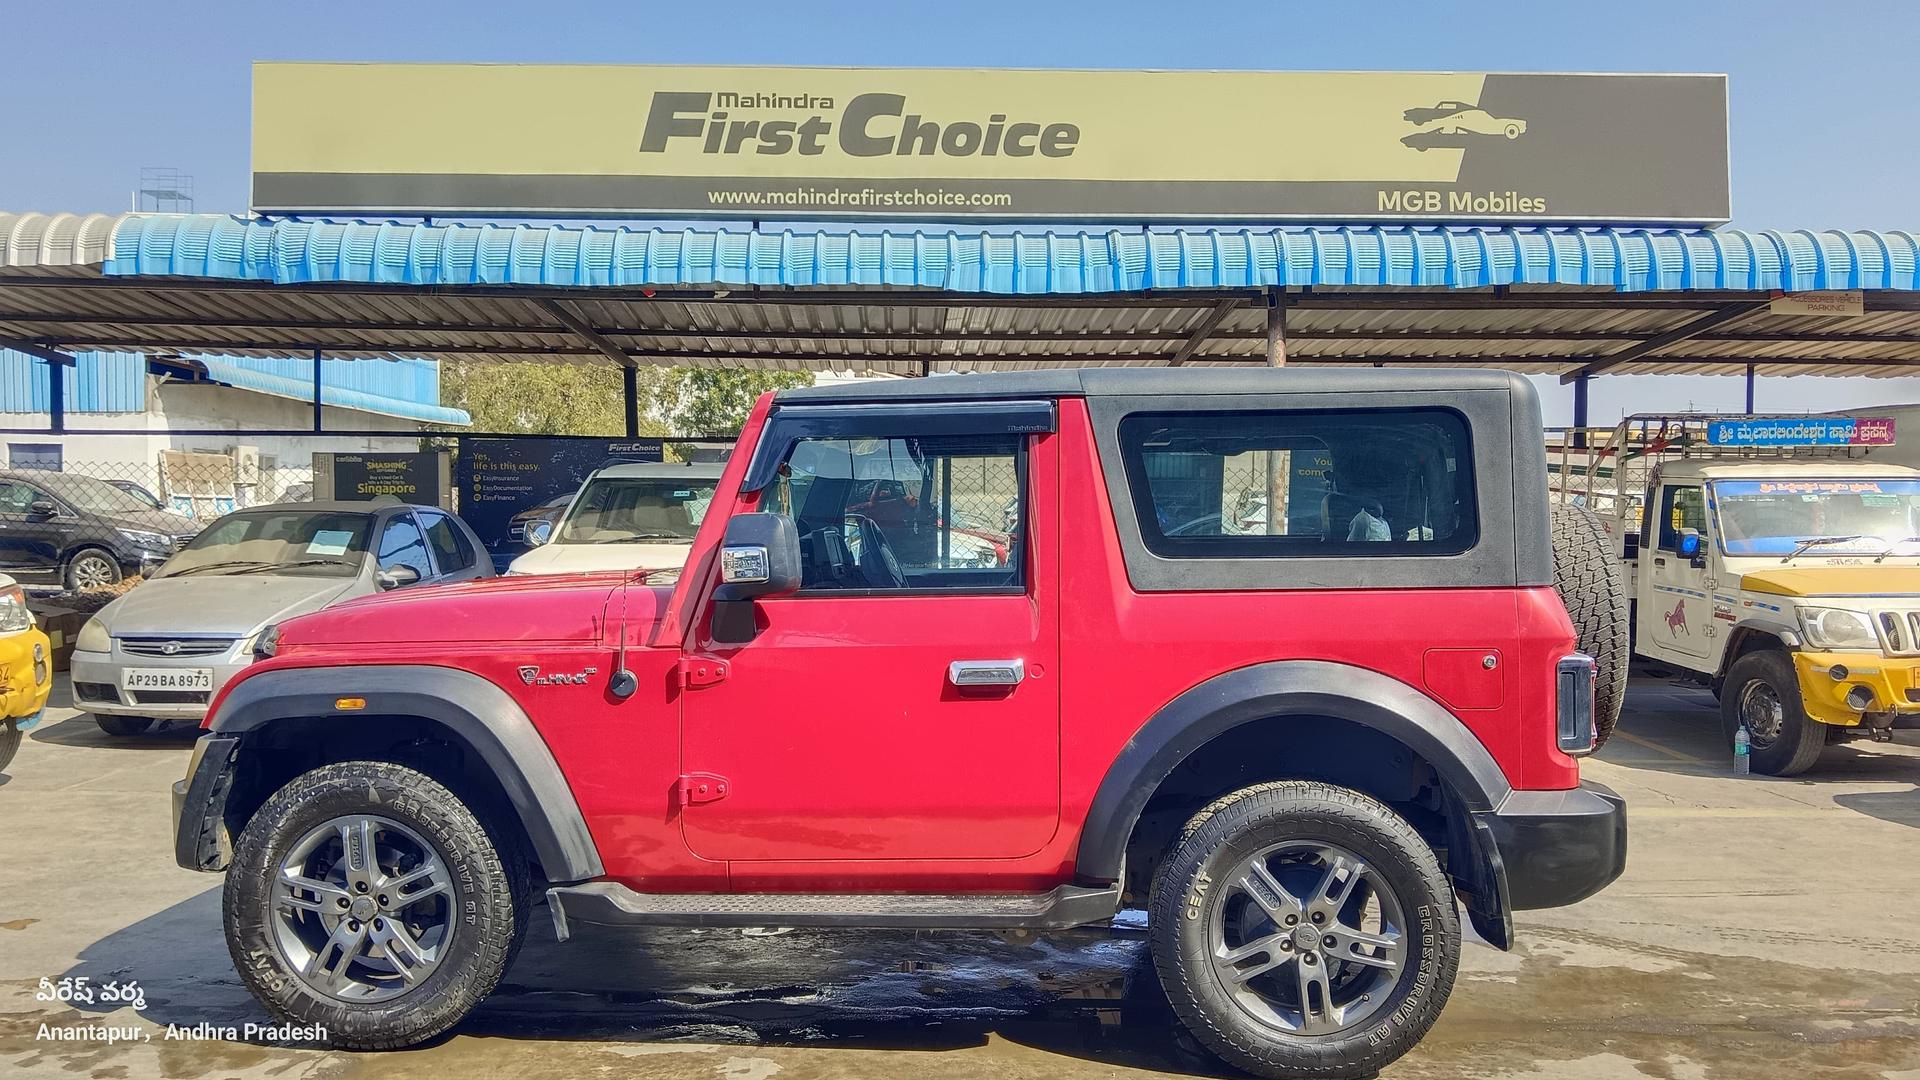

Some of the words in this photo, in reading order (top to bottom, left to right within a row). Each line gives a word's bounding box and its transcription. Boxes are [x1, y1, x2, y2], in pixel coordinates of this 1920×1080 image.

[718, 92, 834, 109] Mahindra
[639, 91, 832, 156] First
[838, 92, 1081, 158] Choice
[707, 188, 1012, 206] www.mahindrafirstchoice.com
[1378, 190, 1442, 212] MGB
[1449, 191, 1546, 213] Mobiles
[1807, 304, 1845, 312] PARKING
[472, 452, 490, 462] Yes,
[473, 462, 488, 470] life
[490, 462, 498, 470] is
[500, 462, 517, 470] this
[357, 484, 416, 495] Singapore
[1186, 871, 1213, 920] CEAT
[250, 950, 285, 993] CEAT
[1392, 904, 1434, 1026] CROSSDRIVE
[1367, 1023, 1391, 1047] AT
